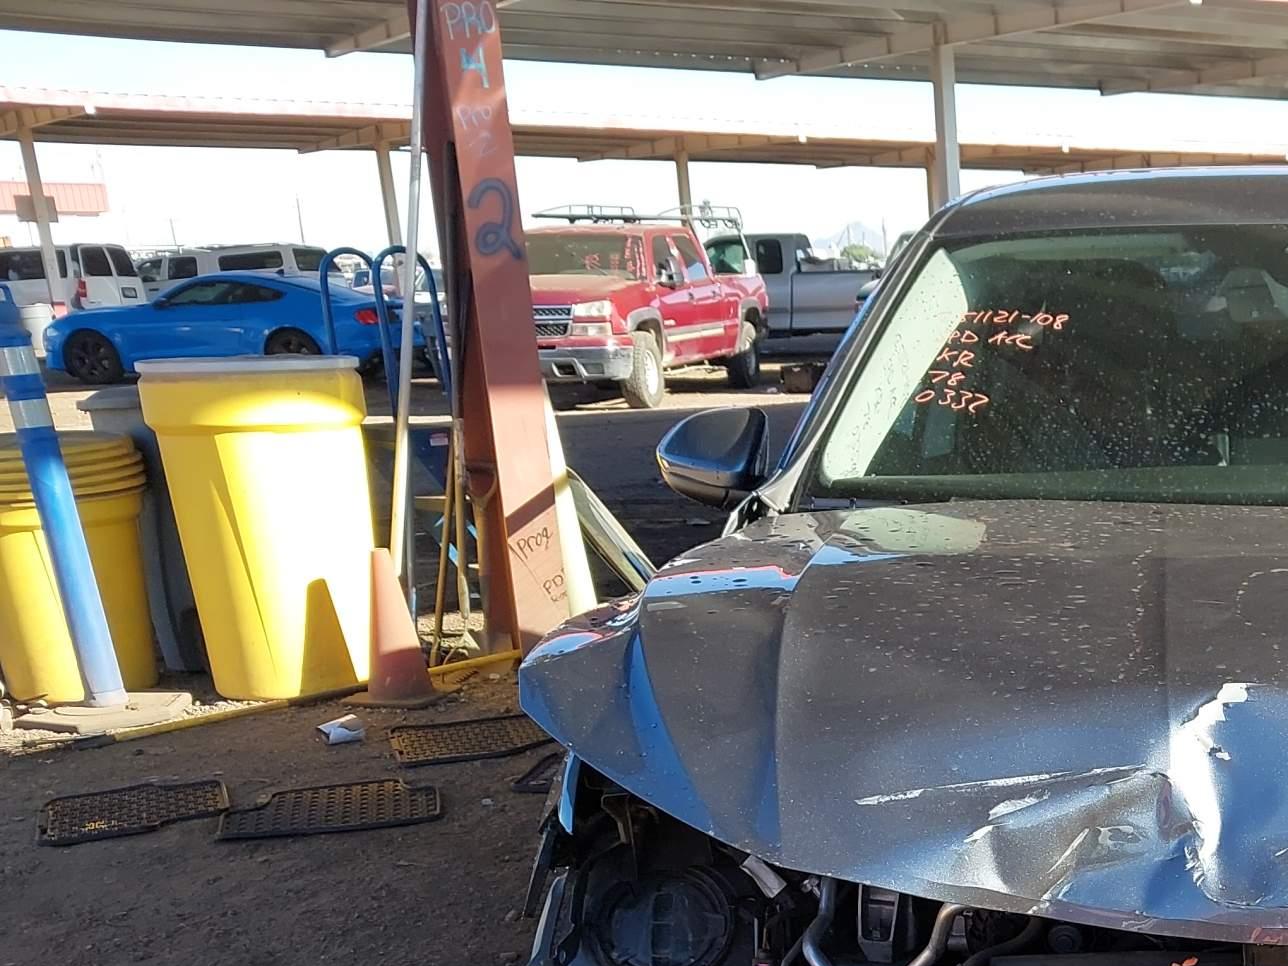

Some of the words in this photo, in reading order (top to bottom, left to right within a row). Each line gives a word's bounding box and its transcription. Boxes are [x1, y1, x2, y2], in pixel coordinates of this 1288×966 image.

[440, 1, 496, 40] PRO
[460, 47, 490, 89] 4
[468, 177, 525, 260] 2
[936, 347, 975, 367] KR
[928, 371, 966, 385] 78
